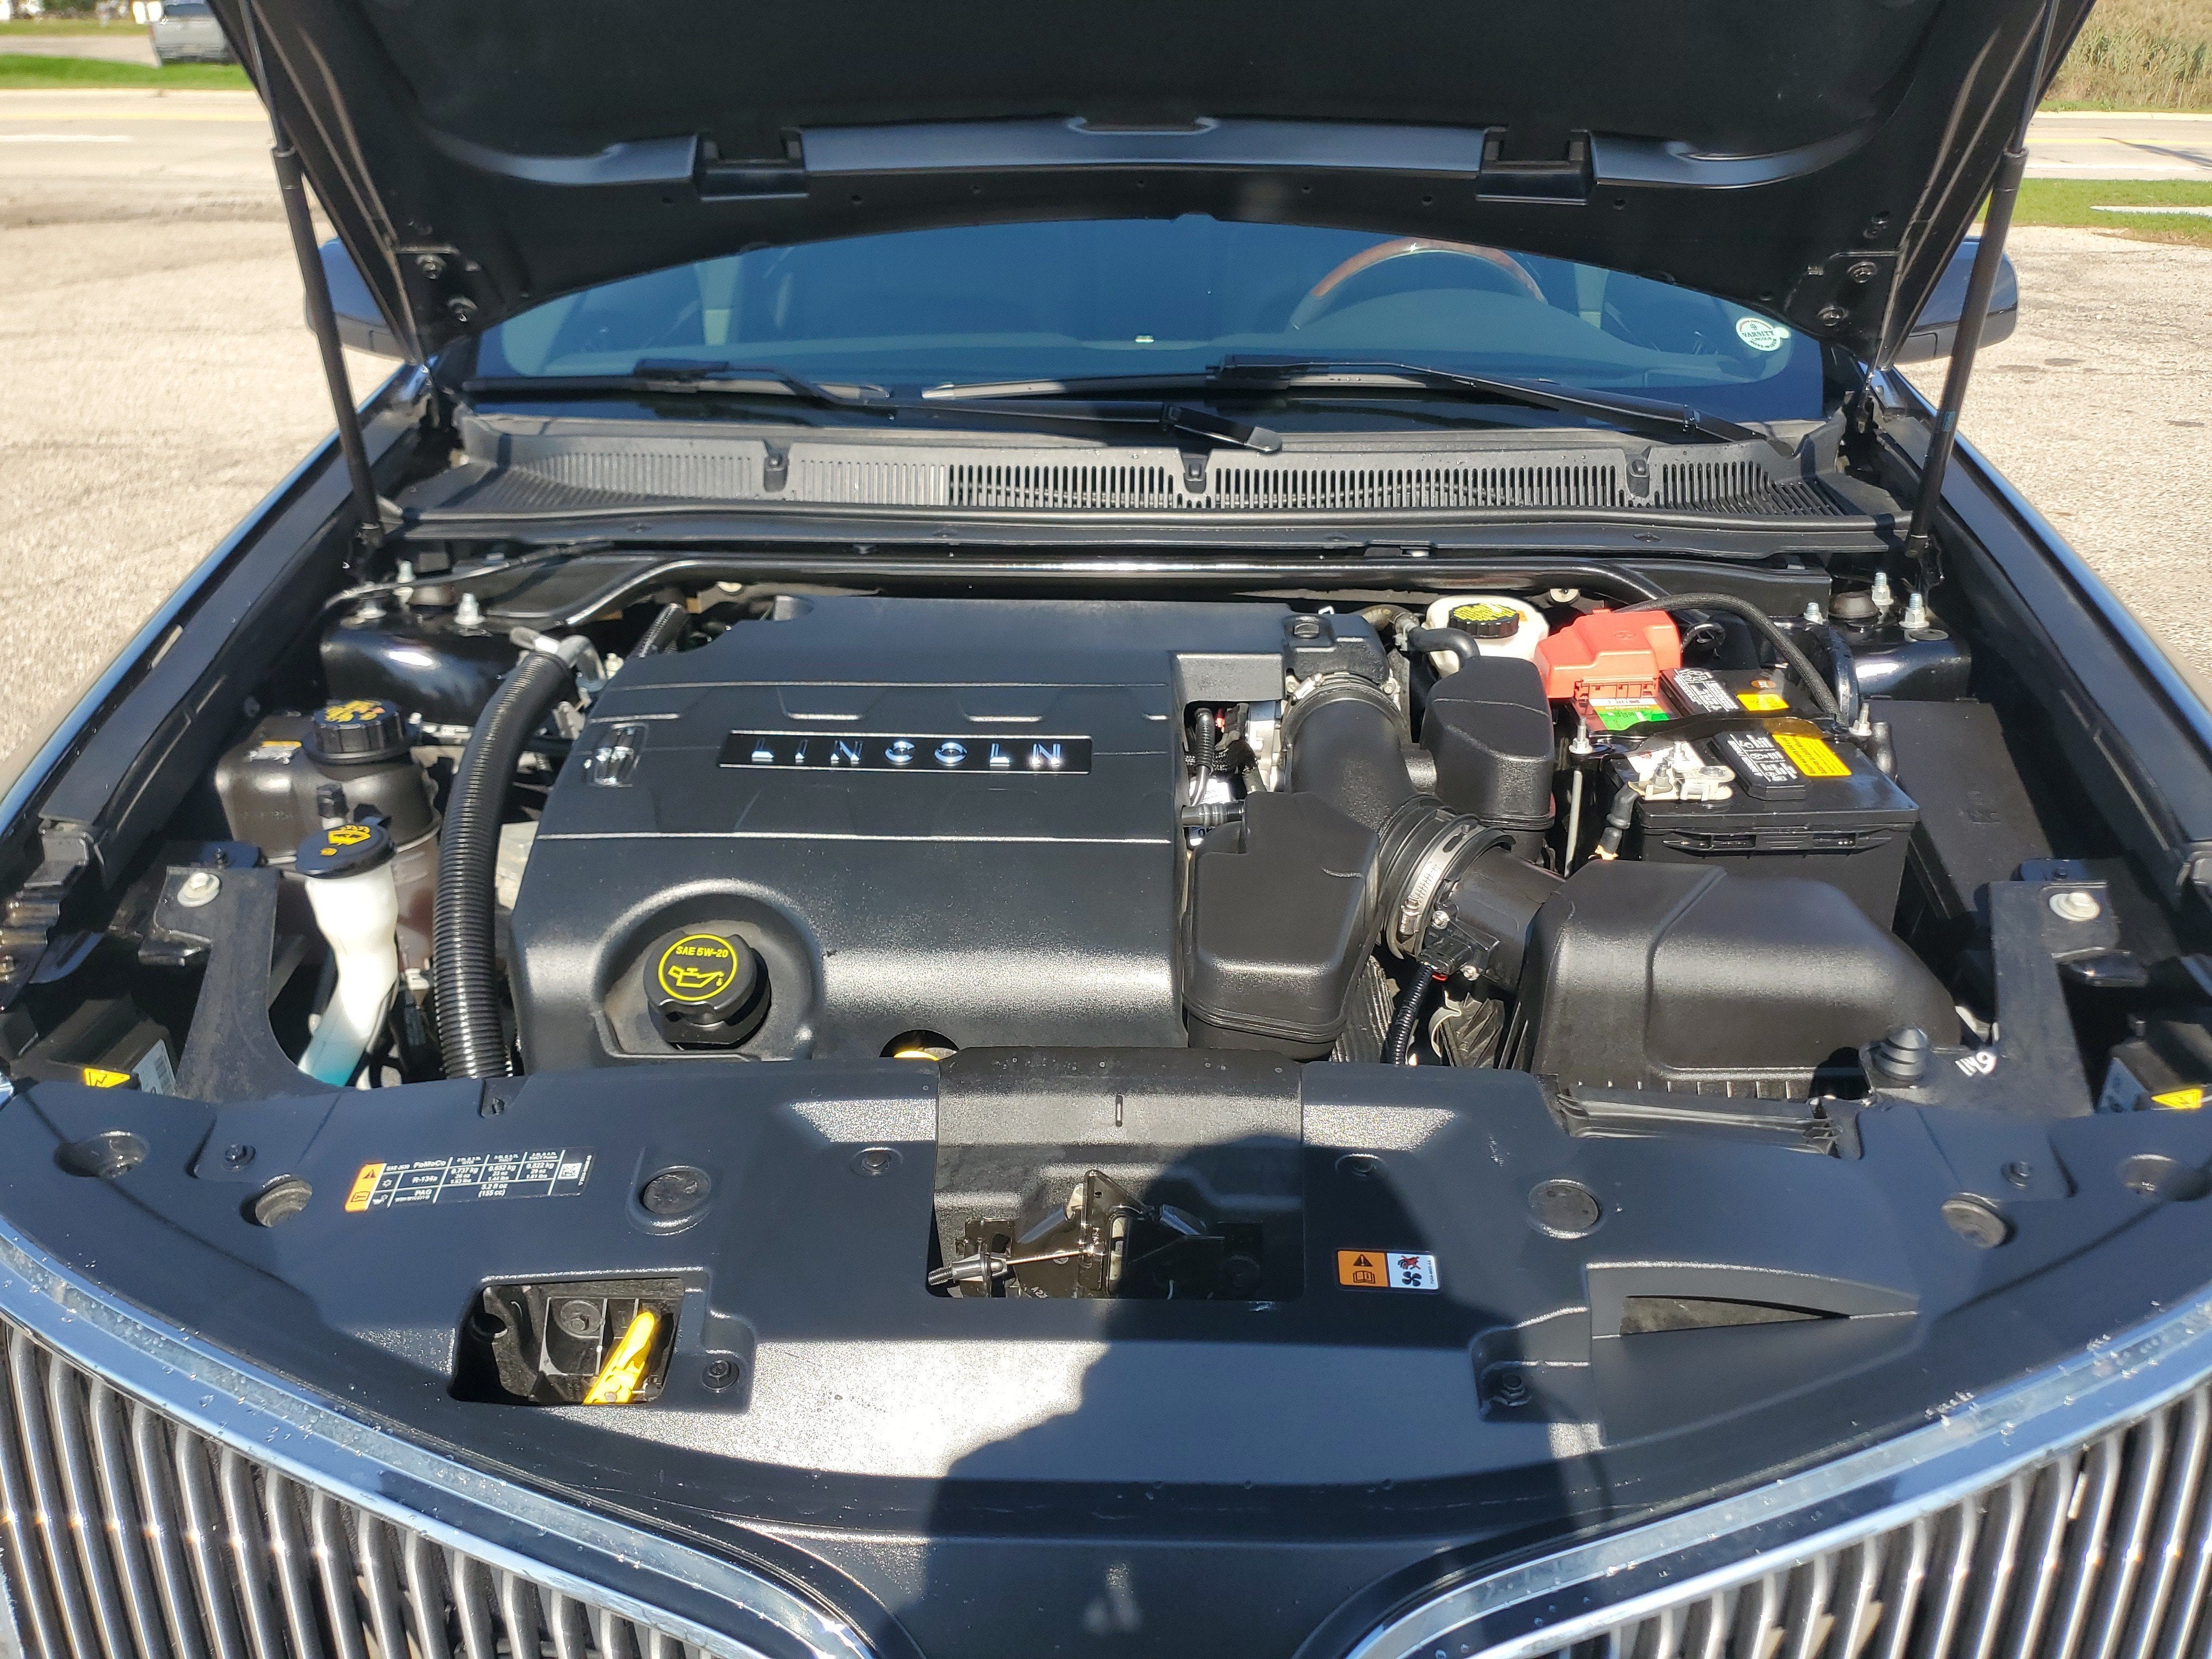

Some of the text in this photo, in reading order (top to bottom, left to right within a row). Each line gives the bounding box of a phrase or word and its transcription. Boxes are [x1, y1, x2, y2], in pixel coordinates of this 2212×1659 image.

[752, 738, 1060, 765] LINCOLN
[675, 946, 729, 958] SAE 5W-20
[414, 1160, 447, 1169] FoMoCo
[413, 1176, 438, 1184] R-134a
